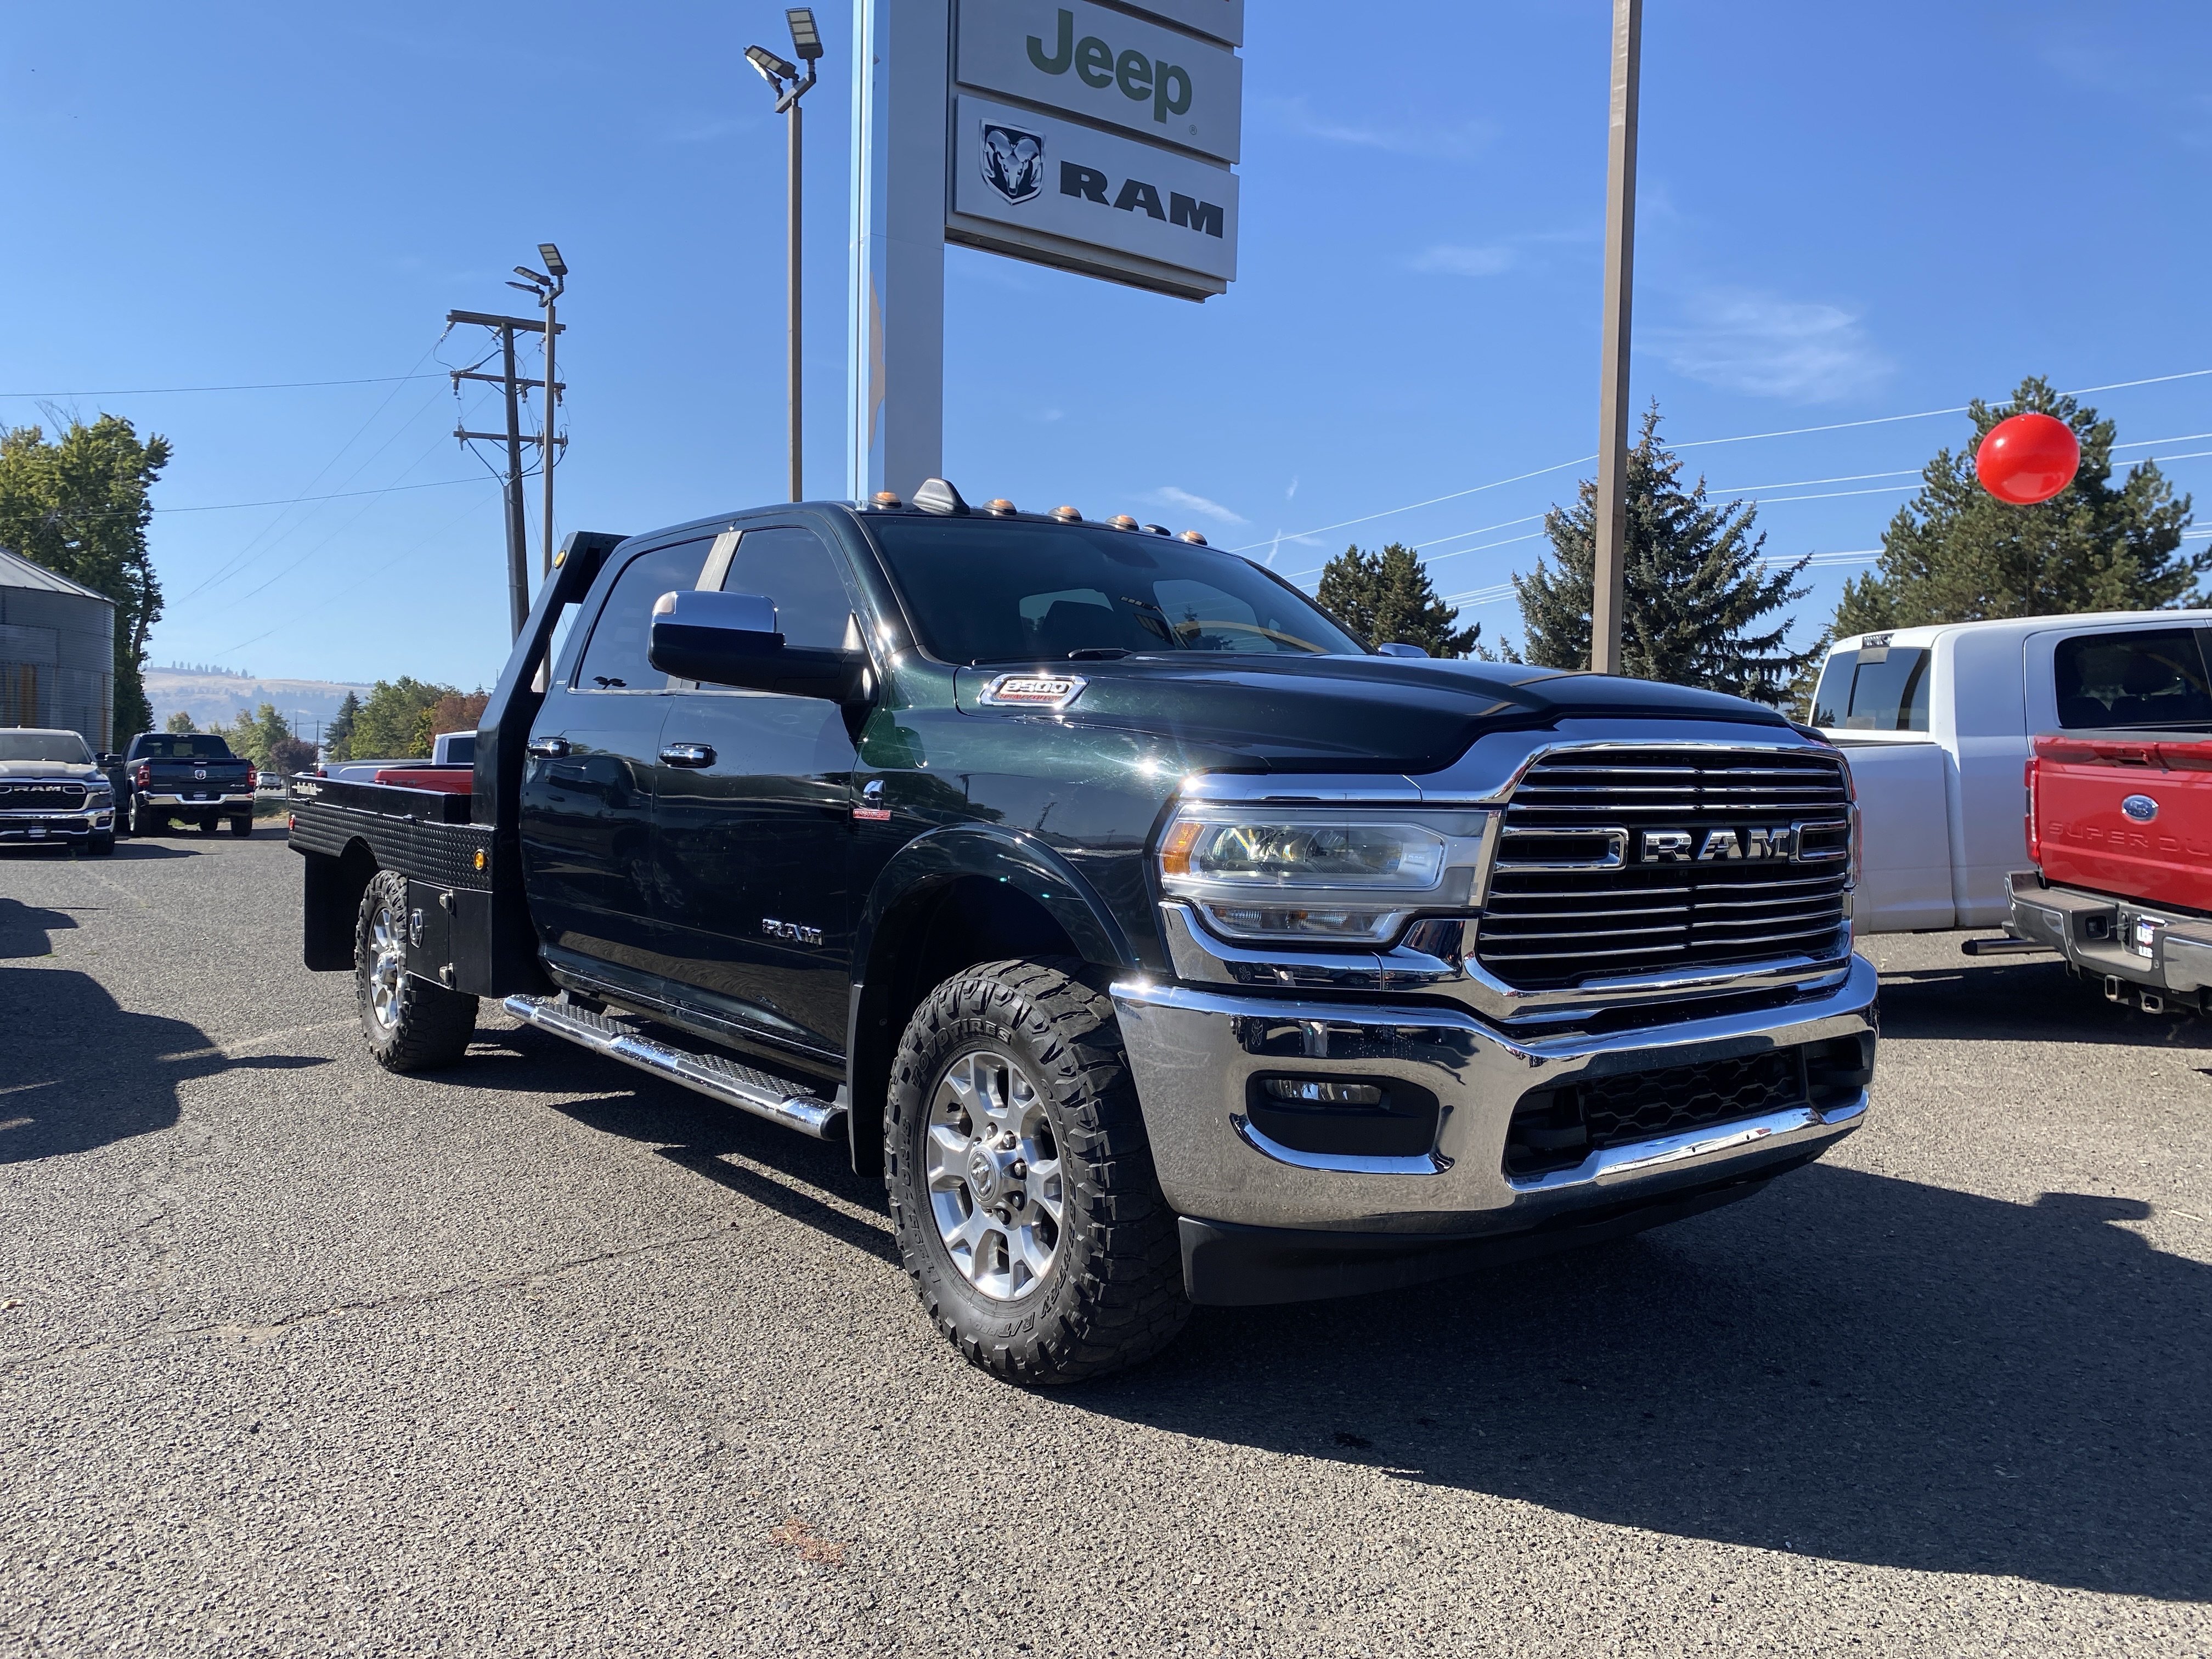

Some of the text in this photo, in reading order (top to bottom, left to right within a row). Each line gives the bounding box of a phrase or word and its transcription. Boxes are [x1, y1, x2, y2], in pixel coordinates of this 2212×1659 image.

[1026, 8, 1192, 124] Jeep
[1060, 161, 1223, 239] RAM
[1641, 828, 1790, 862] RAM
[2049, 821, 2149, 848] SUPER
[763, 918, 822, 945] RAM
[950, 1018, 1012, 1045] TIRES
